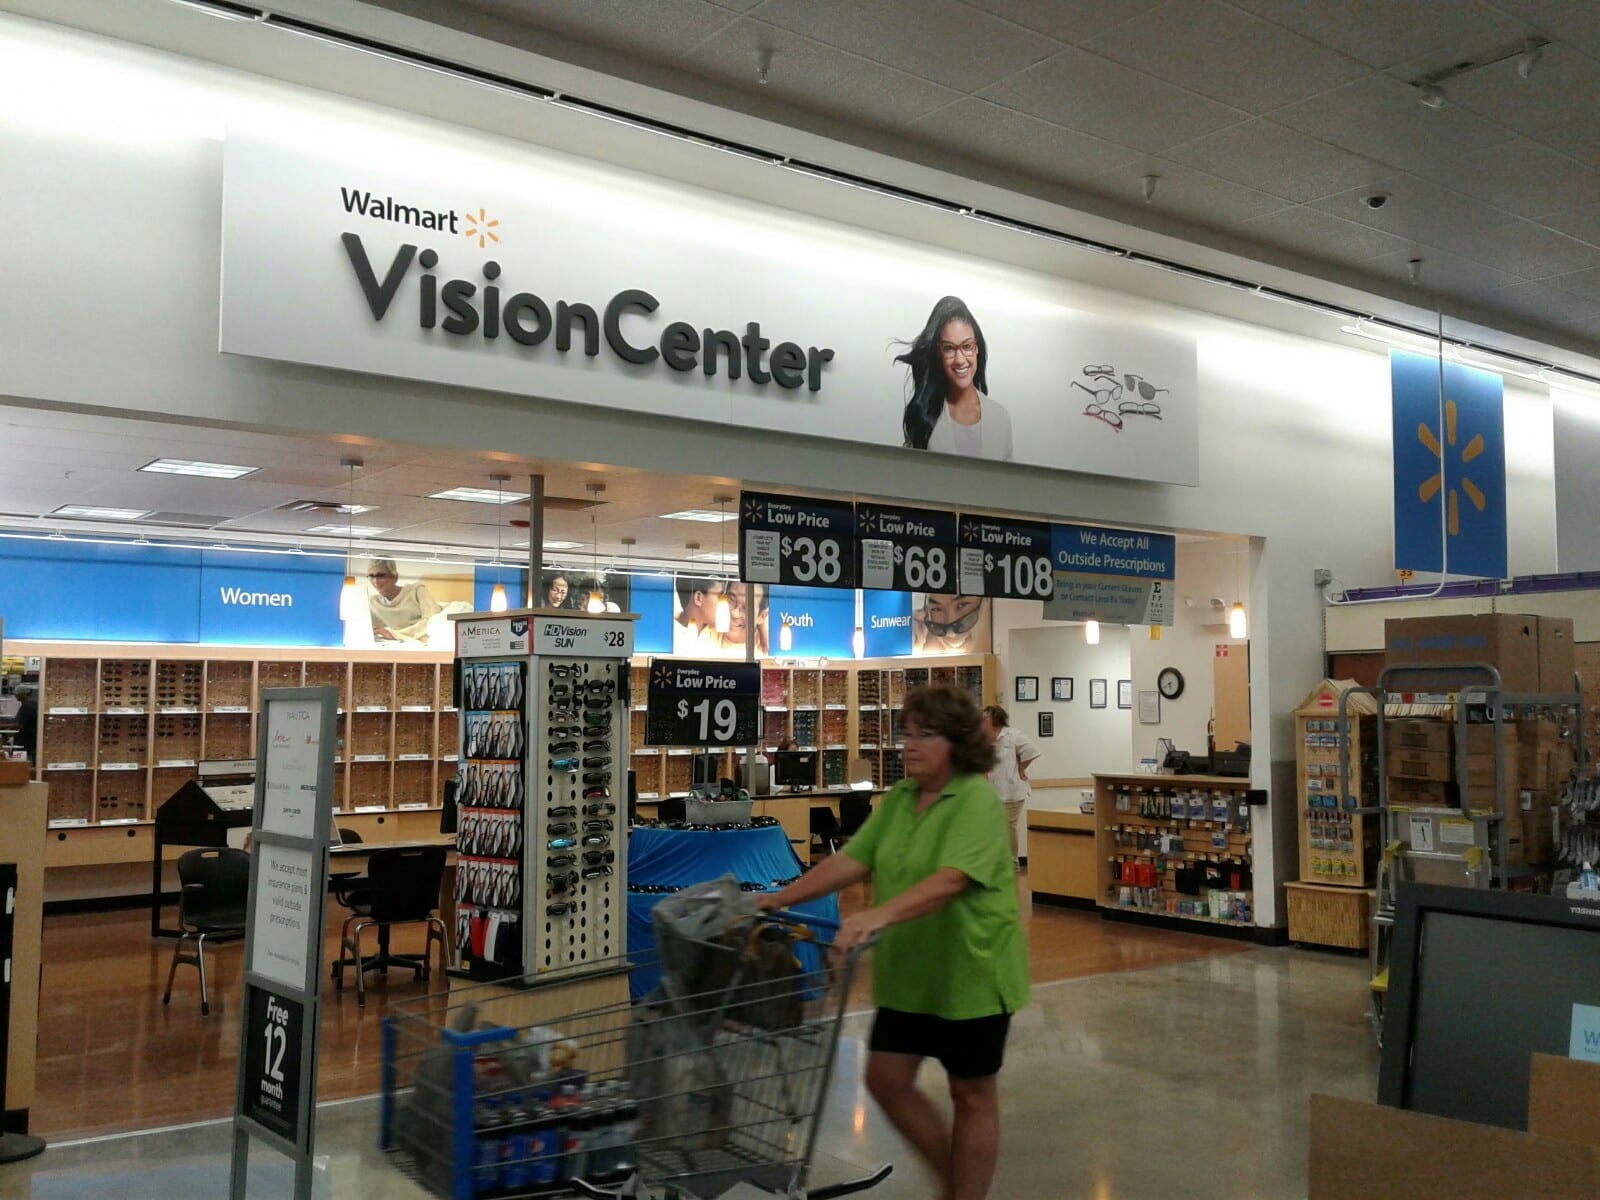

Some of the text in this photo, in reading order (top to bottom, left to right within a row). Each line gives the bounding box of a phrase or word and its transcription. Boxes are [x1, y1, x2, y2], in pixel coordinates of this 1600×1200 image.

[341, 187, 458, 234] Walmart
[768, 509, 830, 528] Low Price
[880, 519, 935, 537] Low Price
[982, 529, 1032, 546] Low Price
[1080, 530, 1149, 551] We Accept All
[781, 536, 841, 583] $38
[1058, 550, 1166, 574] Outside Prescriptions
[220, 586, 292, 607] Women
[780, 612, 814, 627] Youth
[871, 614, 912, 629] Sunwear
[554, 638, 574, 648] SUN
[604, 631, 625, 647] $28
[676, 668, 700, 676] Everyday
[676, 675, 736, 689] Low Price
[677, 698, 737, 741] $19
[266, 995, 289, 1027] Free
[264, 1022, 287, 1082] 12
[261, 1079, 283, 1100] month
